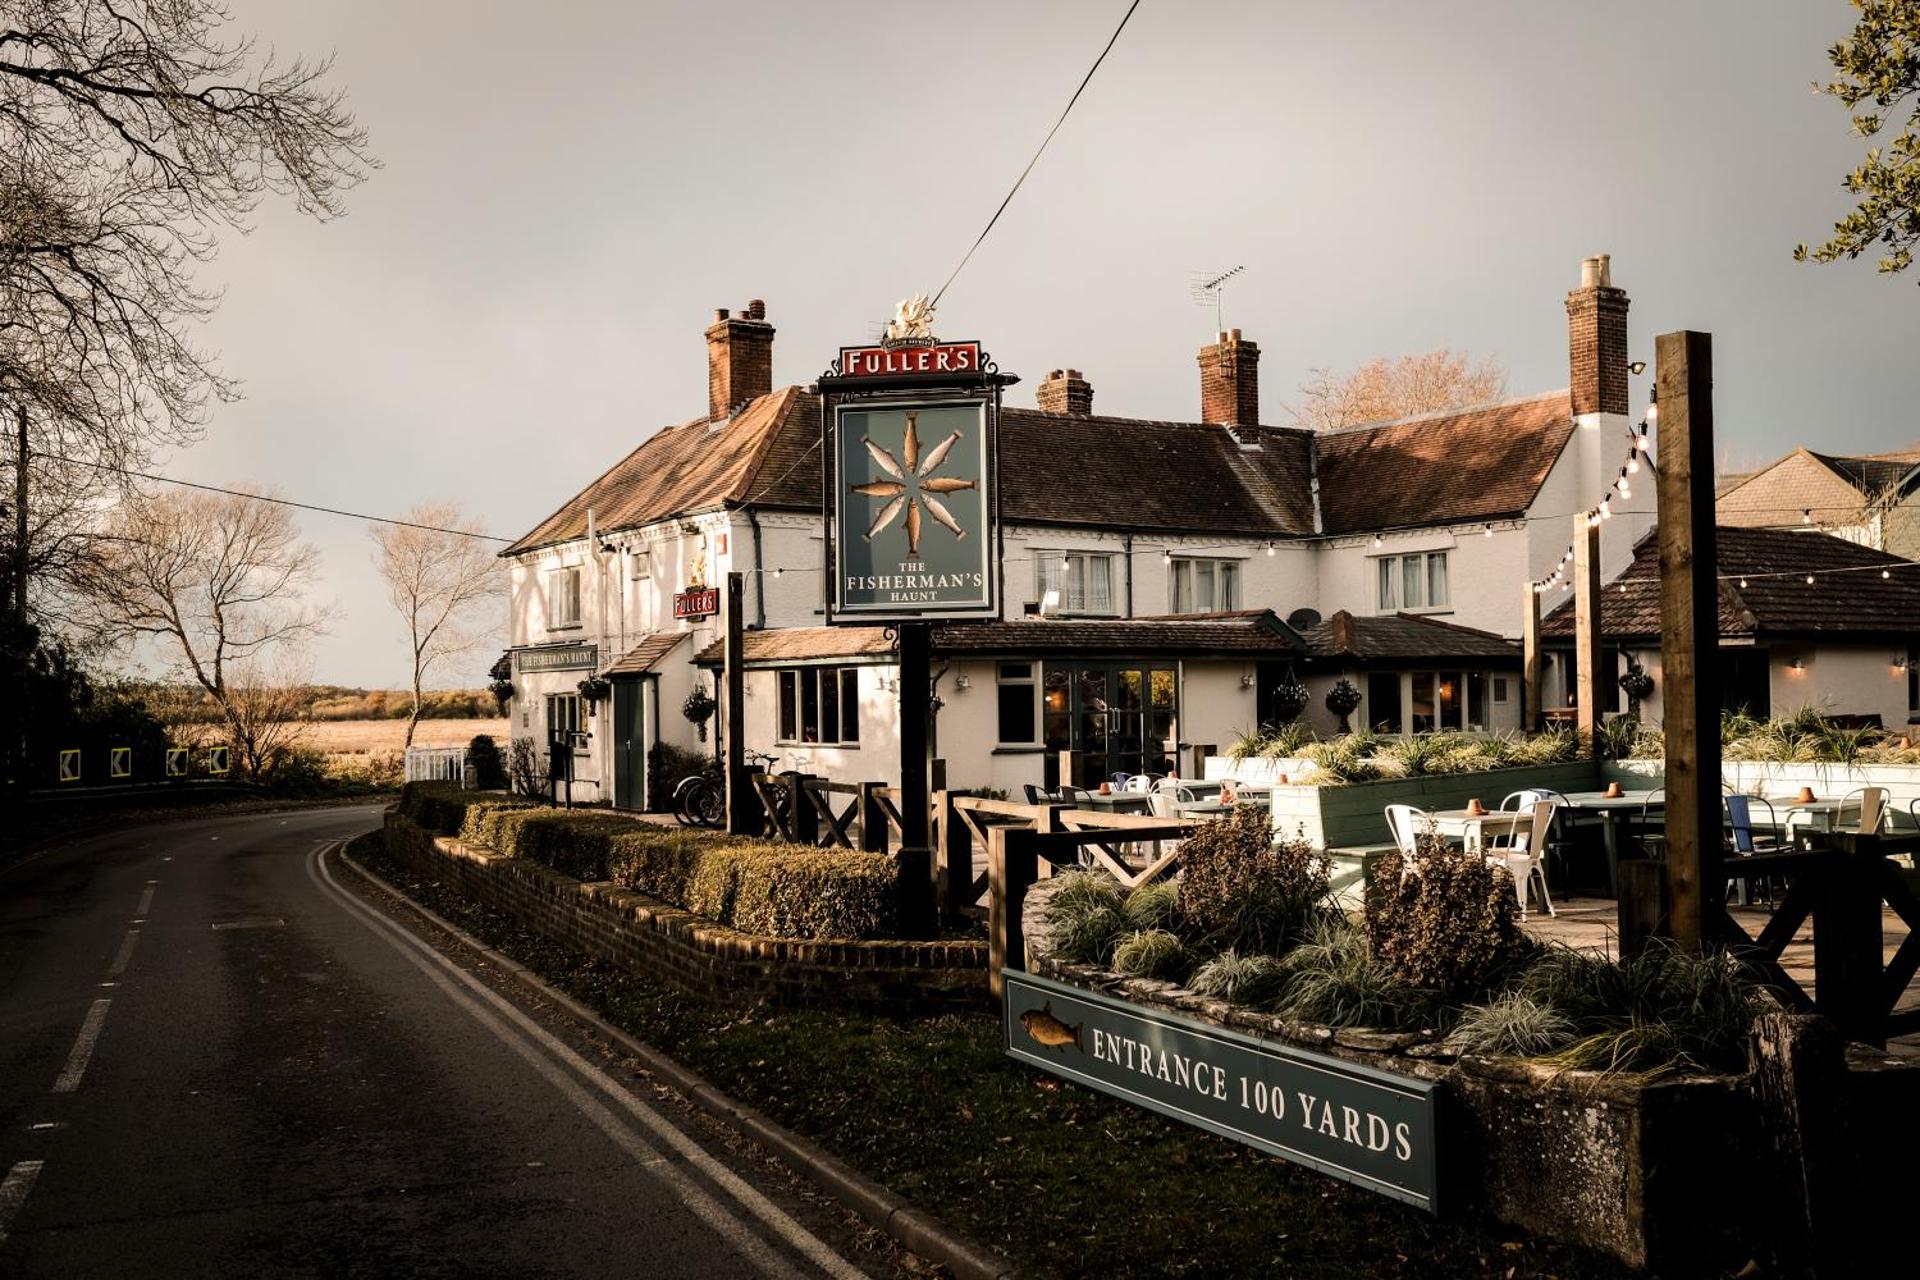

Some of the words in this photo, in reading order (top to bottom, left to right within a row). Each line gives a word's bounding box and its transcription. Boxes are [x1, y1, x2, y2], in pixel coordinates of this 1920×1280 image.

[850, 348, 969, 373] FULLER'S
[898, 562, 926, 572] THE
[847, 573, 983, 590] FISHERMAN'S
[891, 591, 938, 601] HAUNT
[1092, 1028, 1228, 1101] ENTRANCE
[1239, 1077, 1285, 1119] 100
[1298, 1092, 1412, 1161] YARDS
